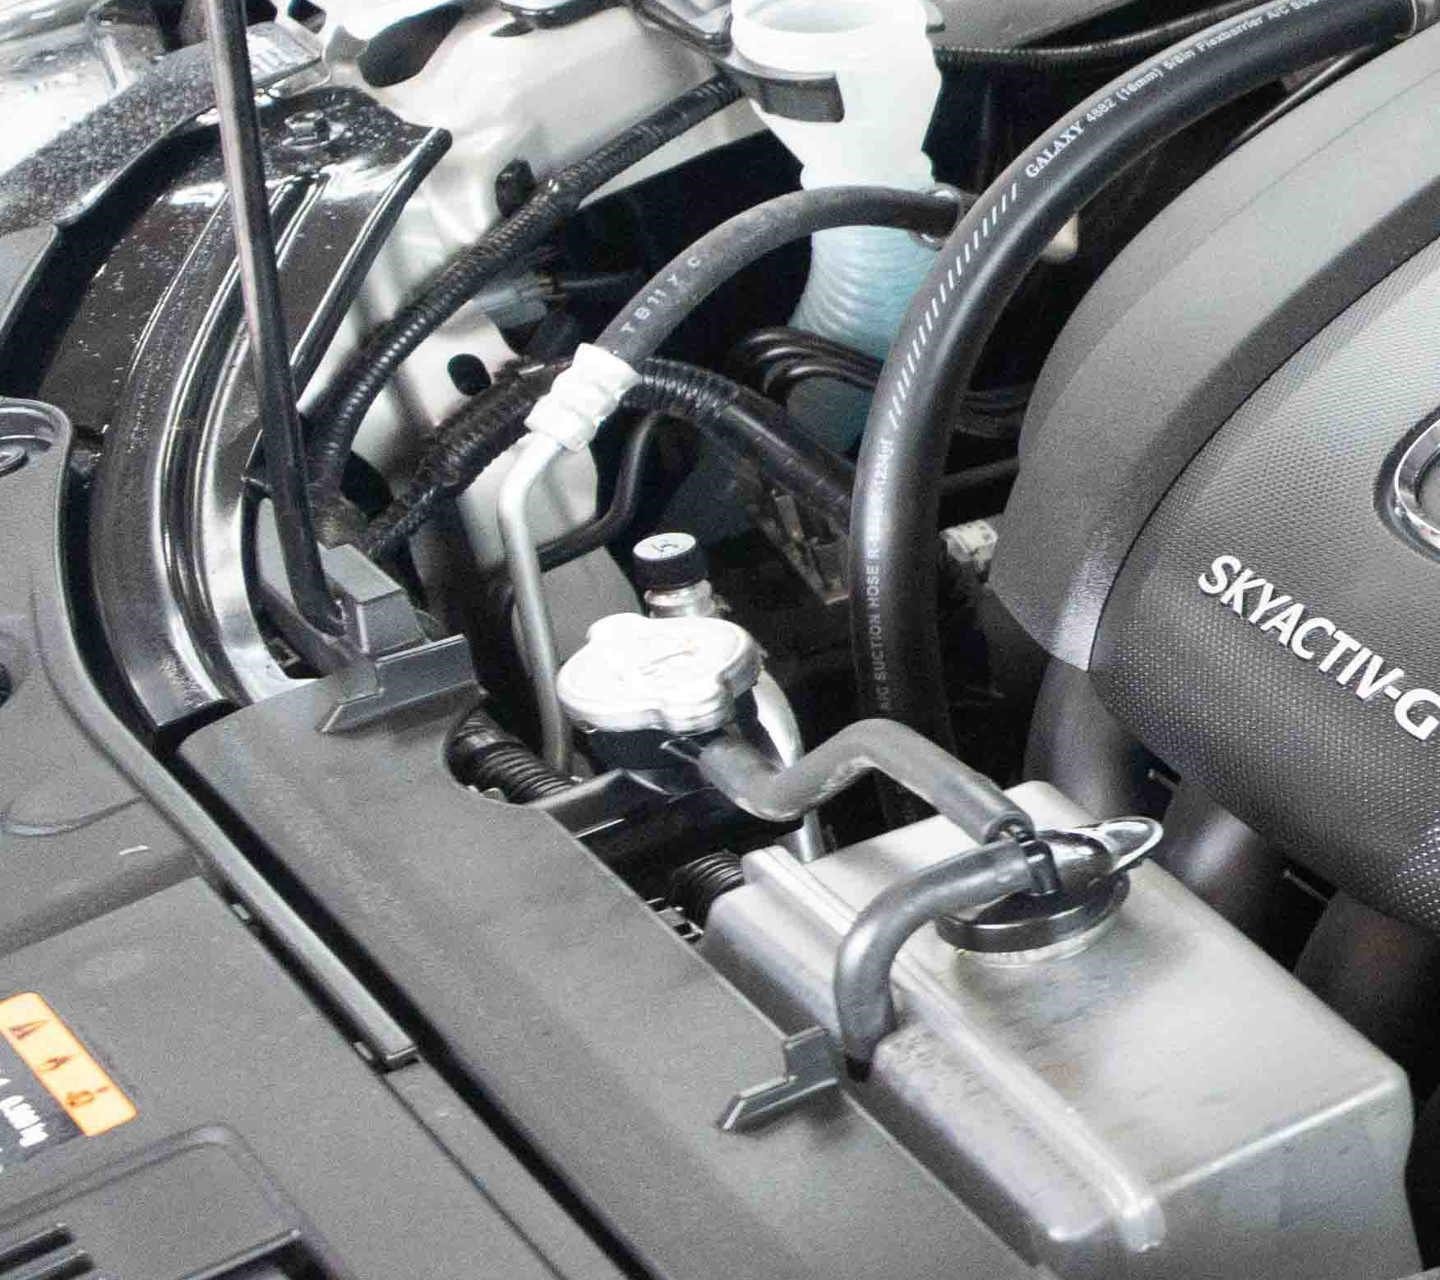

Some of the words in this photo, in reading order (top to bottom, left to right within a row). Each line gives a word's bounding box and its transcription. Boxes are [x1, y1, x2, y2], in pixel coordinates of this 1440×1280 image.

[1025, 120, 1085, 178] GALAXY
[865, 564, 882, 610] HOSE
[868, 613, 887, 681] SUCTION
